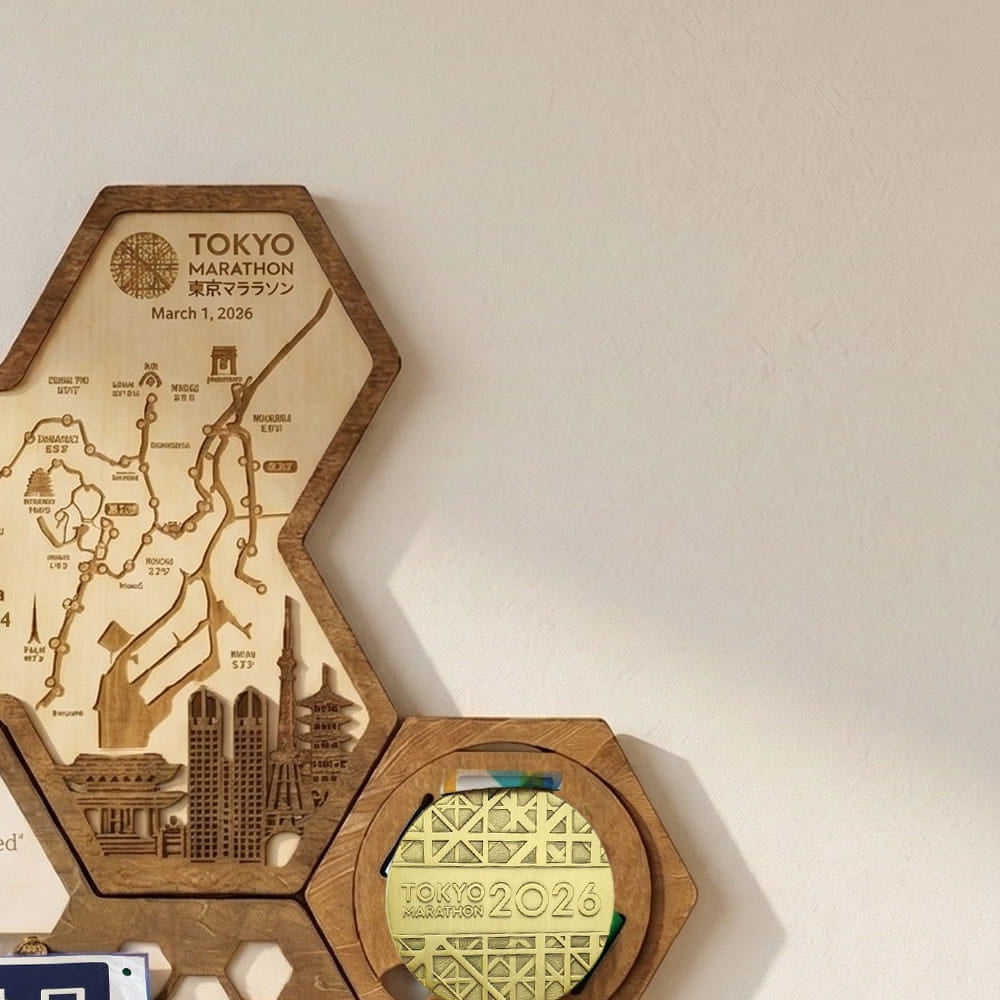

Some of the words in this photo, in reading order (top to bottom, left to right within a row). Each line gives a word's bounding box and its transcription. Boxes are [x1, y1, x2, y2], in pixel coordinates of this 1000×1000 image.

[188, 232, 295, 256] TOKYO
[188, 261, 294, 276] MARATHON
[151, 306, 197, 320] March
[201, 307, 214, 322] 1,
[217, 306, 253, 320] 2026
[400, 881, 486, 903] TOKYO
[488, 881, 602, 918] 2026
[401, 904, 485, 920] MARATHON
